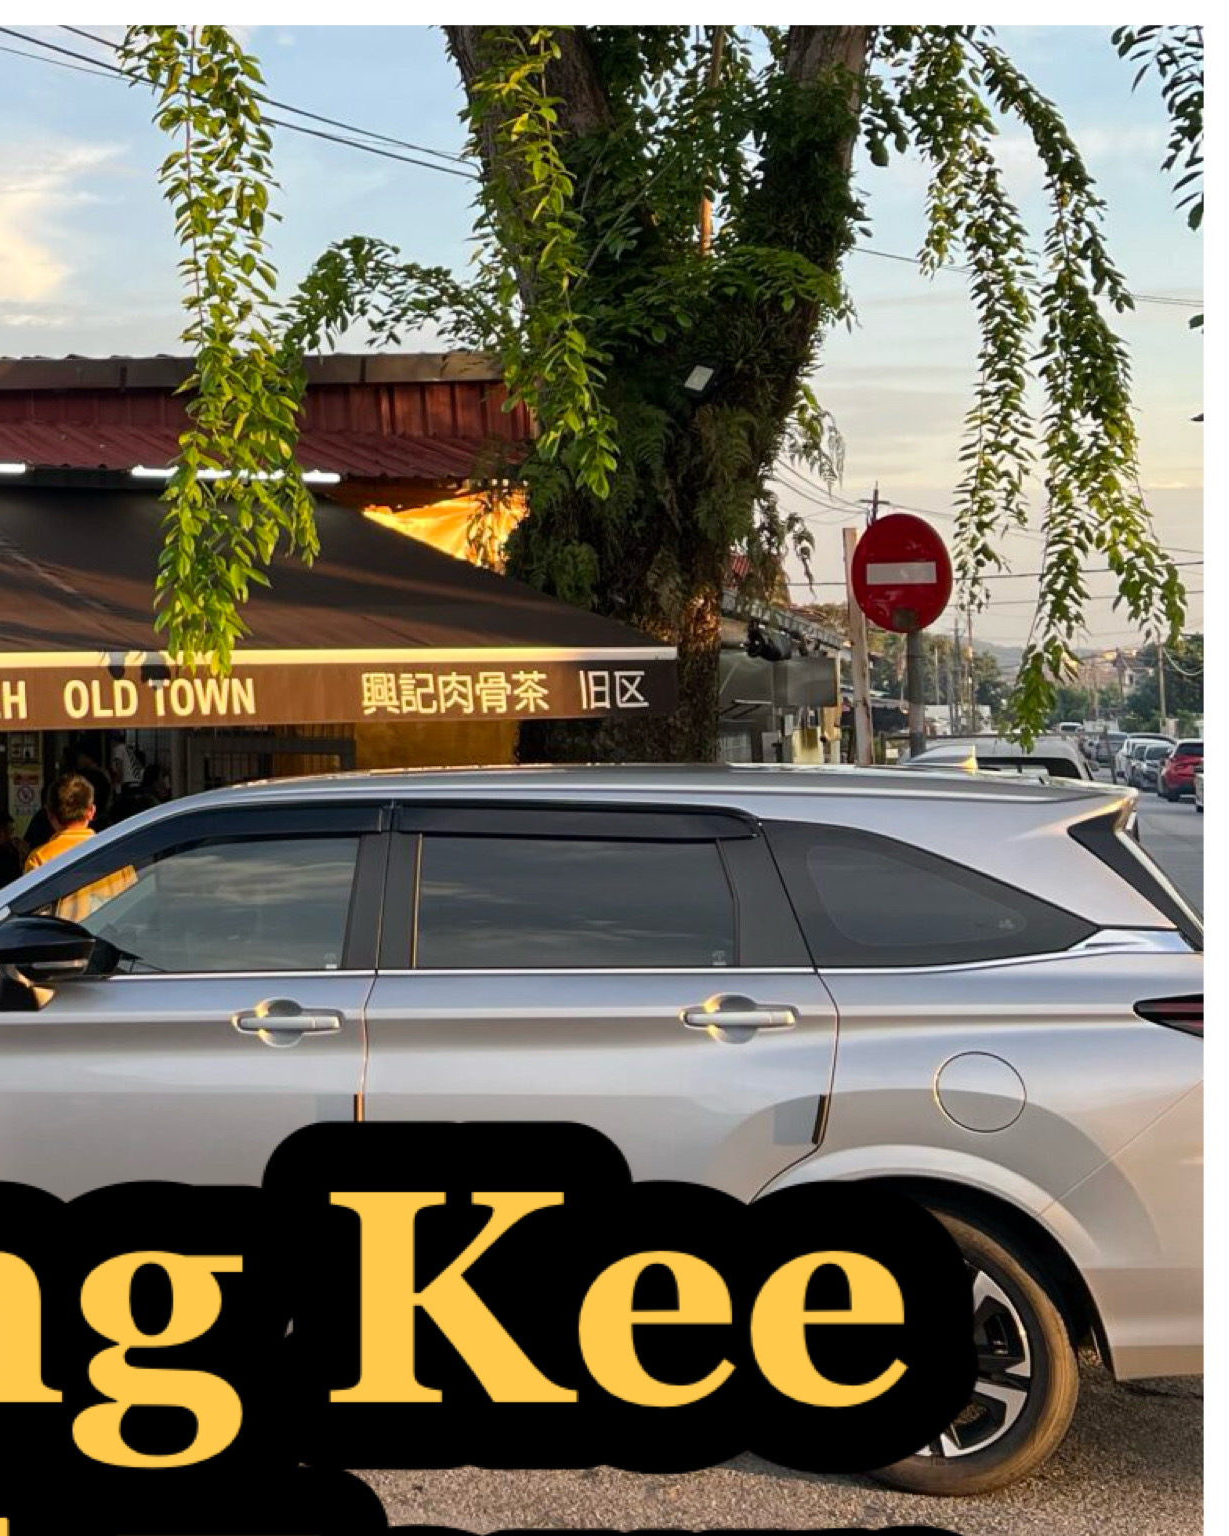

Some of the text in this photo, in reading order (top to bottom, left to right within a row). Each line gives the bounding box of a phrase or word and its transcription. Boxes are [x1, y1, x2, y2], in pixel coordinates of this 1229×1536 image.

[63, 679, 138, 719] OLD
[148, 678, 255, 717] TOWN
[361, 670, 650, 715] 興記肉骨茶 旧区
